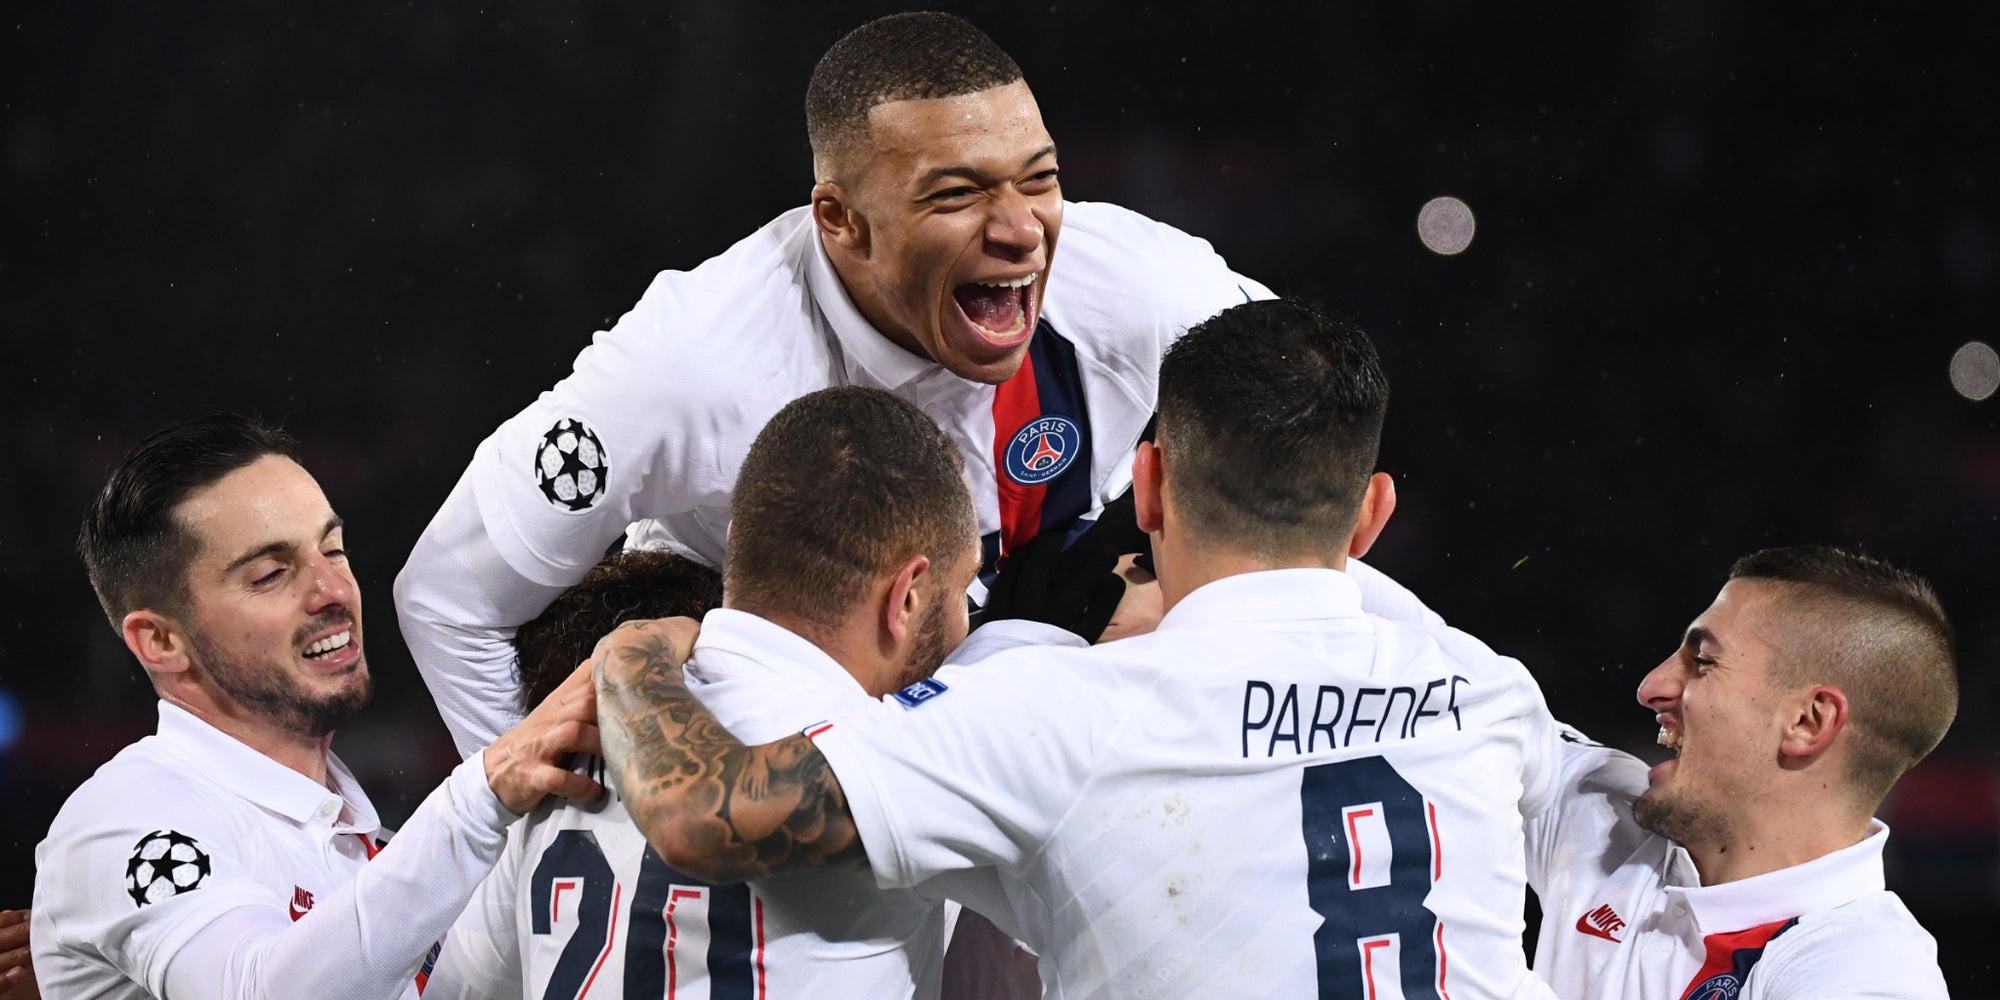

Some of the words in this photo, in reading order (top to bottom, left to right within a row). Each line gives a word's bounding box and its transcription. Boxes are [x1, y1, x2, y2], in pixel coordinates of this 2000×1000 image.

[1018, 421, 1067, 444] PARIS
[1301, 755, 1450, 1000] 8
[294, 884, 314, 910] NIKE
[1590, 903, 1626, 932] NIKE
[1706, 978, 1738, 997] PARIS
